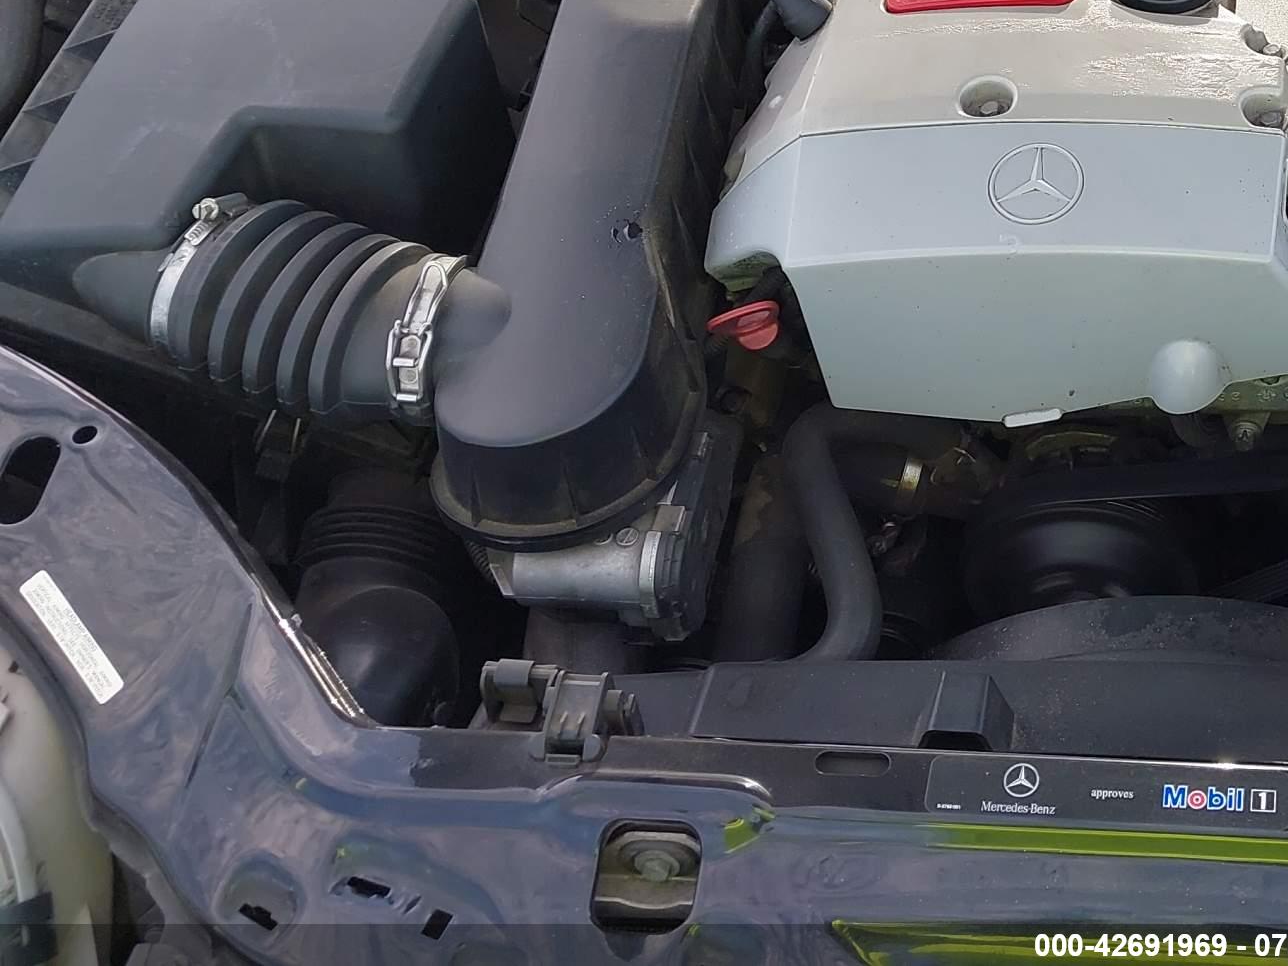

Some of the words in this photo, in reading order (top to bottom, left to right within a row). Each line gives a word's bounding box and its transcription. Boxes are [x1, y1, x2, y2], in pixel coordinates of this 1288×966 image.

[1090, 787, 1134, 800] approves
[1162, 784, 1245, 811] Mobil
[980, 800, 1057, 815] Mercedes-Benz
